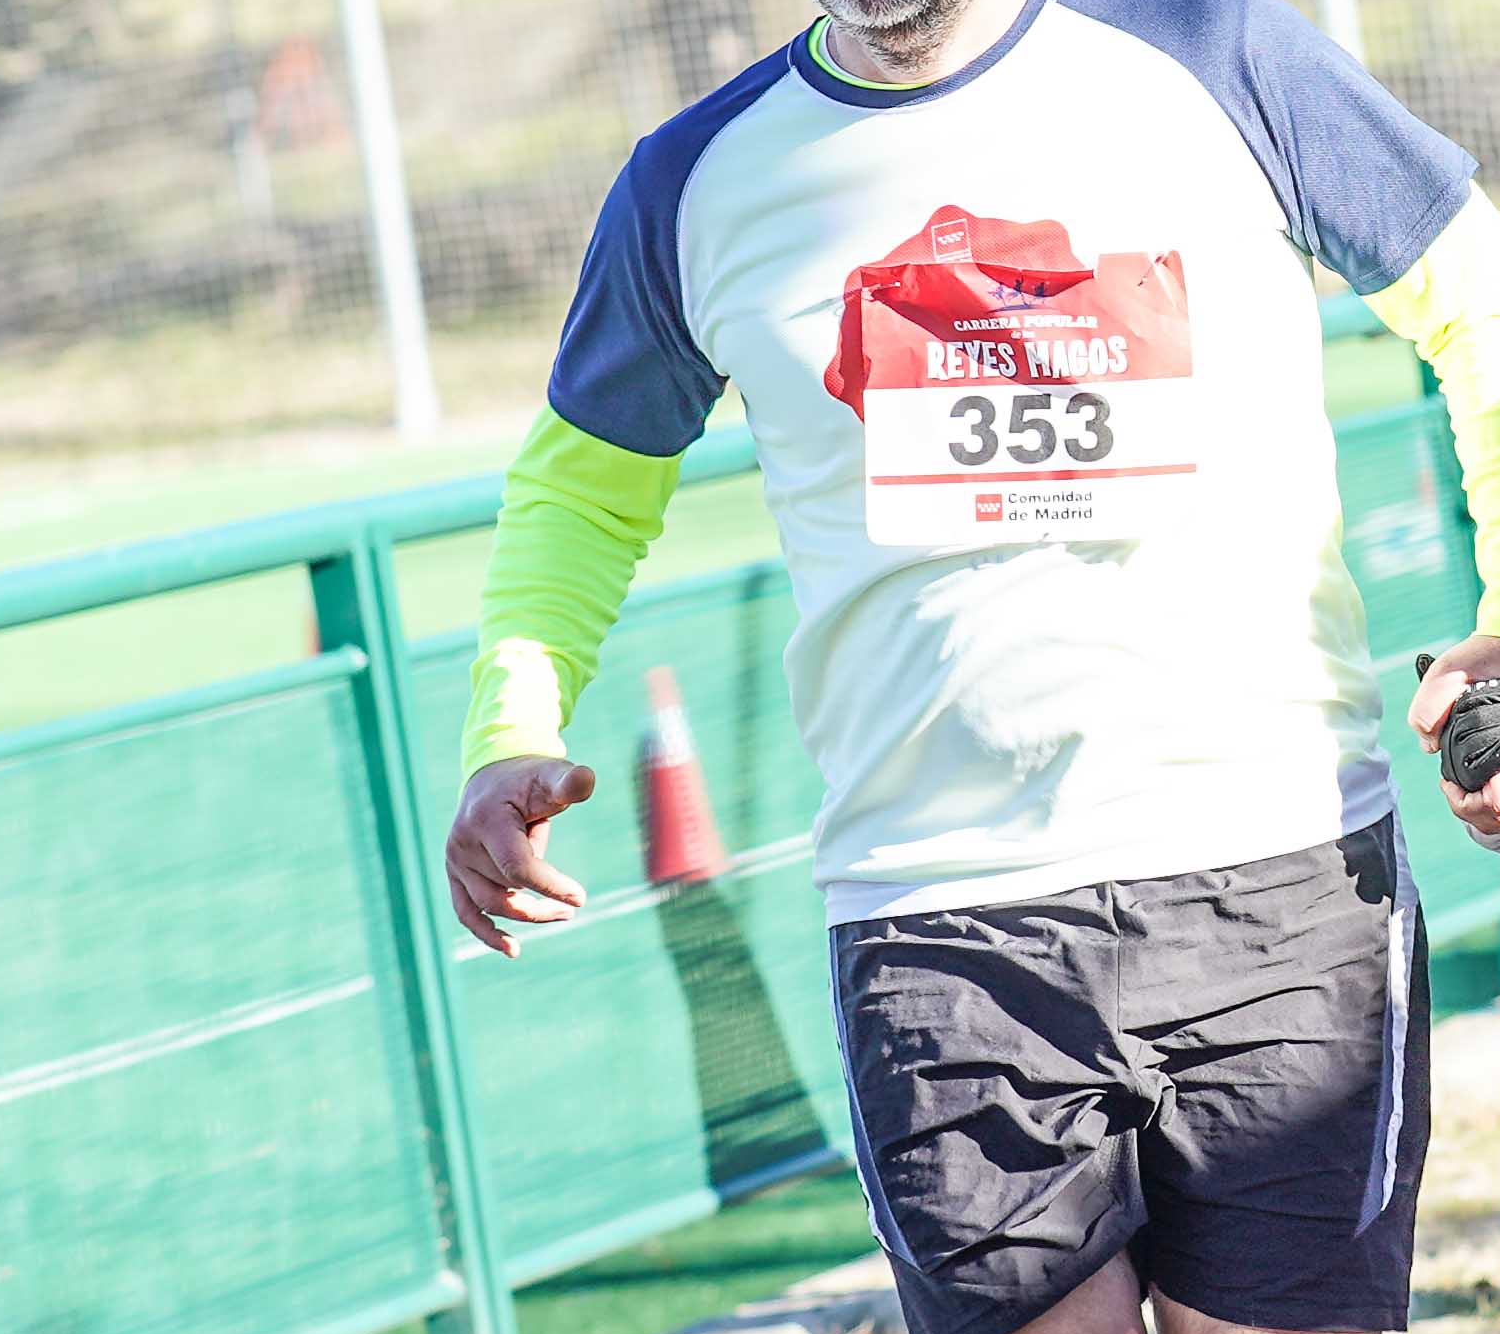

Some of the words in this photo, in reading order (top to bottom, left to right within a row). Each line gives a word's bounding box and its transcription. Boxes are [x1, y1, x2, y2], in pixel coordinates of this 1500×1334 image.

[953, 317, 1020, 332] CARRERA
[927, 340, 1017, 381] REYES
[1024, 336, 1129, 379] MAGOS
[948, 392, 1114, 466] 353
[1008, 491, 1093, 504] Comunidad
[1008, 508, 1028, 522] de
[1035, 506, 1093, 522] Madrid
